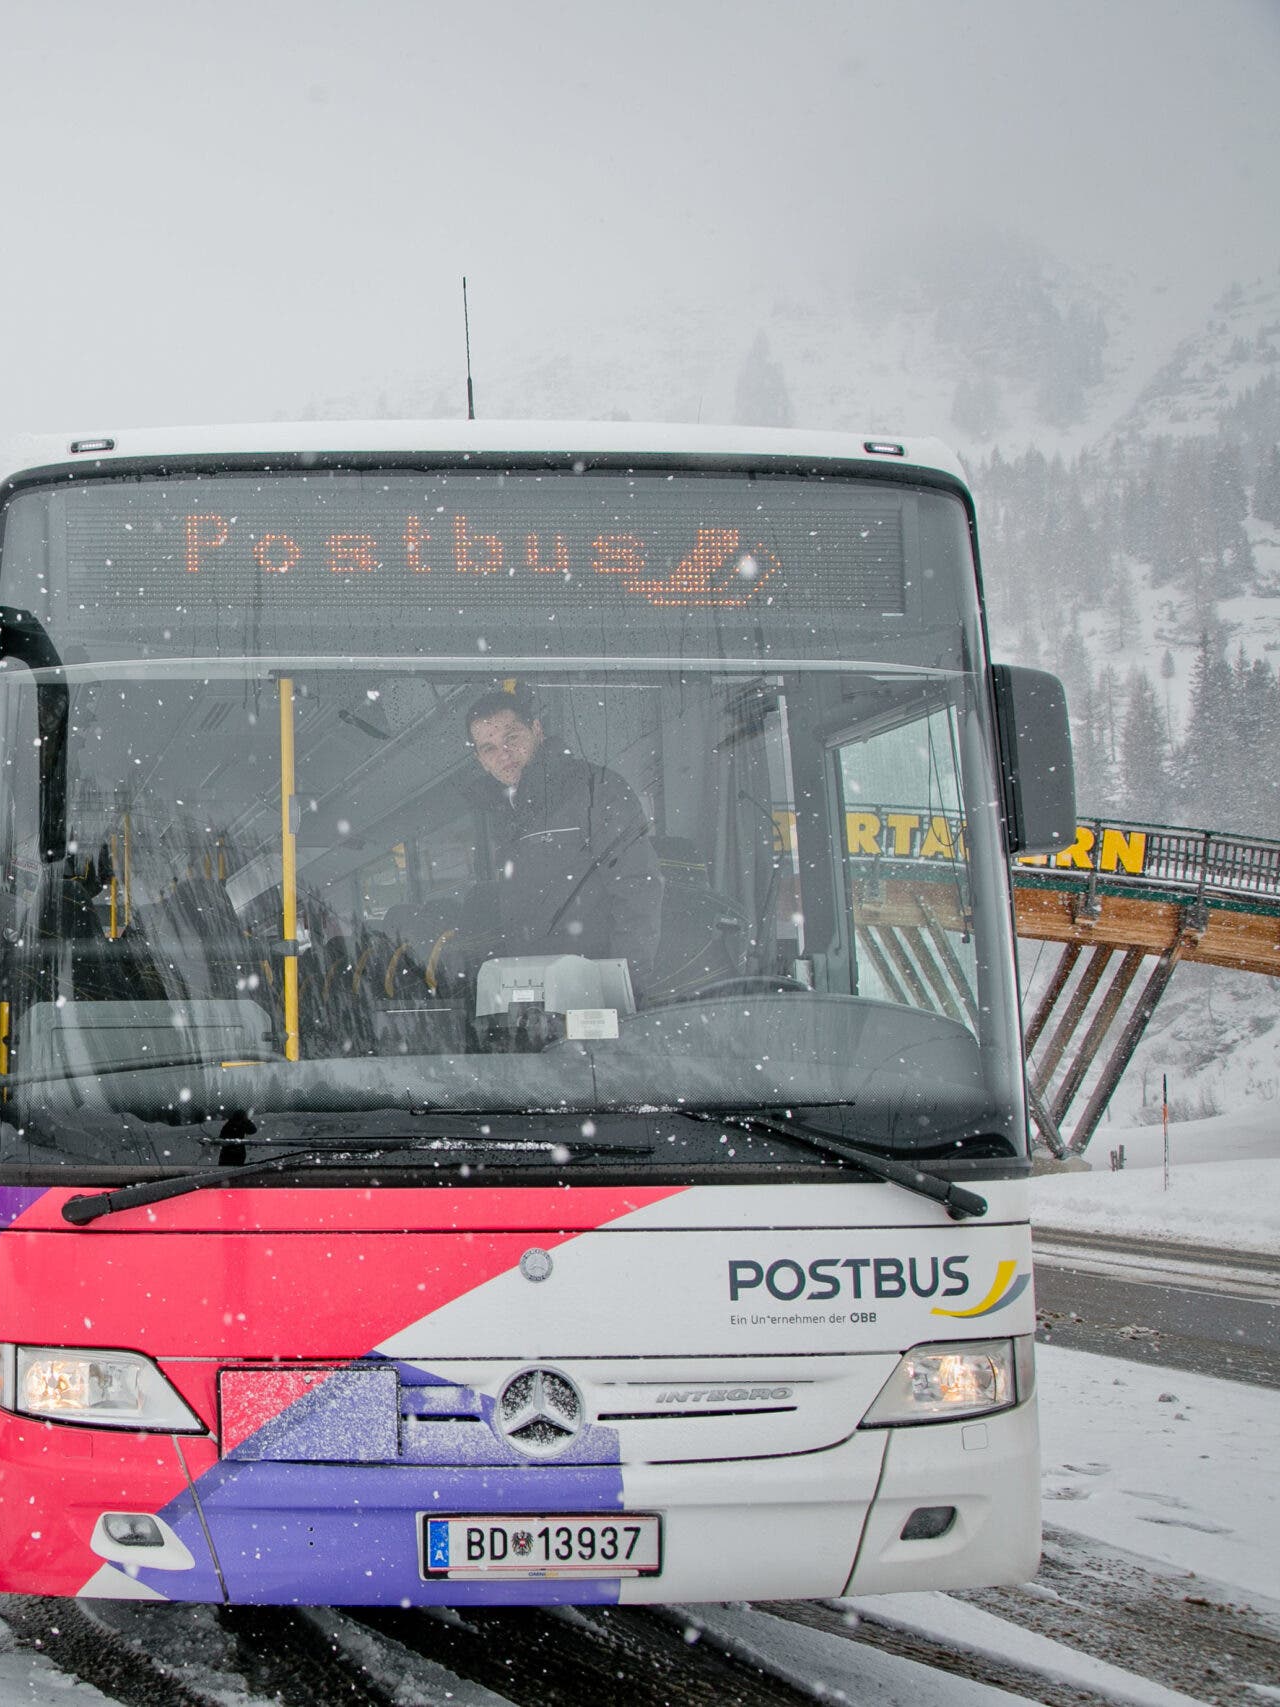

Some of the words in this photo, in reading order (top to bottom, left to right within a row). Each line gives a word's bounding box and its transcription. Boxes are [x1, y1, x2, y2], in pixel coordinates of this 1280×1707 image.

[185, 513, 646, 574] Postbus
[728, 1255, 969, 1301] POSTBUS
[730, 1314, 747, 1325] Ein
[751, 1313, 826, 1325] Unernehmen
[829, 1312, 846, 1324] der
[850, 1312, 877, 1323] ÖBB
[656, 1387, 793, 1403] INTEGRO
[434, 1550, 444, 1561] A
[467, 1527, 508, 1561] BD
[537, 1526, 642, 1561] 13937
